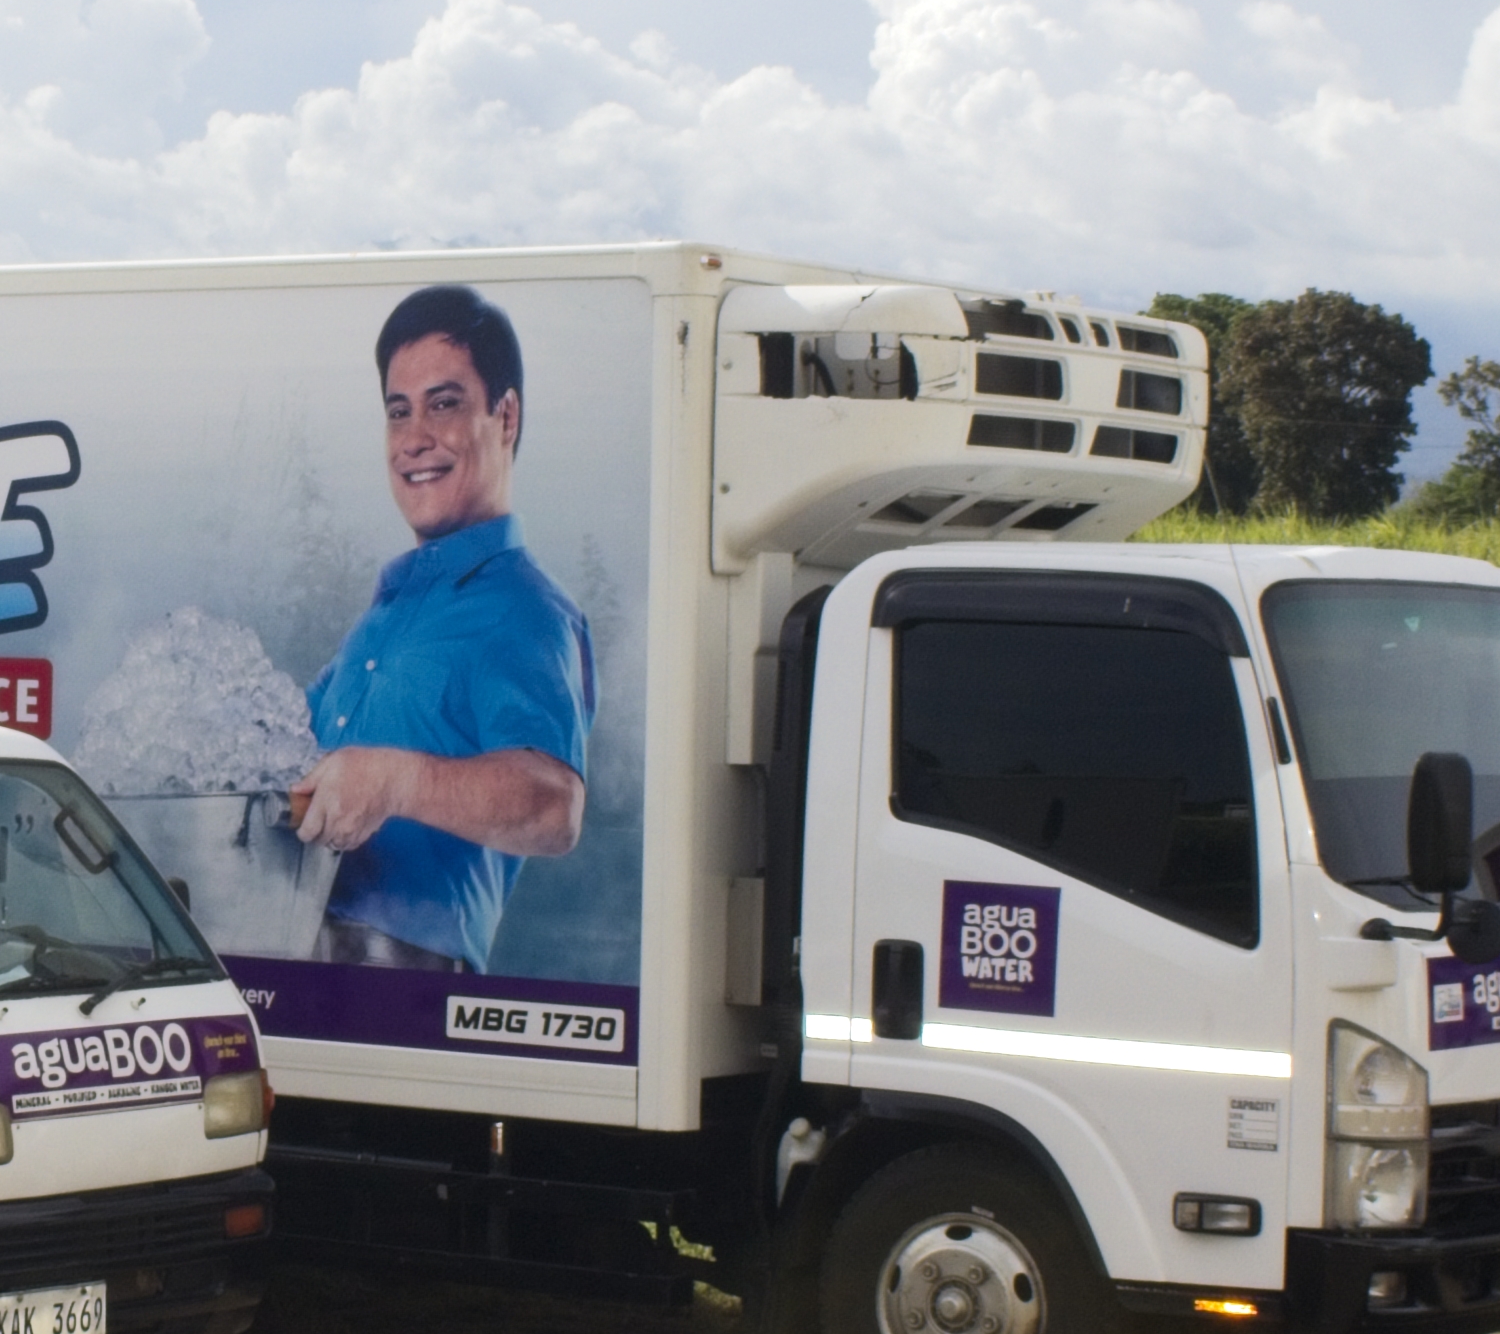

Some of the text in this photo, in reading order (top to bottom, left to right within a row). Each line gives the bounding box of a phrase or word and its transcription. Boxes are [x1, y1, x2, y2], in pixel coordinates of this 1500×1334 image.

[963, 903, 1036, 932] agua
[961, 925, 1037, 959] BOO
[962, 955, 1034, 983] WATER
[453, 1004, 618, 1042] MBG 1730
[11, 1022, 192, 1089] aguaBOO
[1230, 1099, 1276, 1113] CAPACITY
